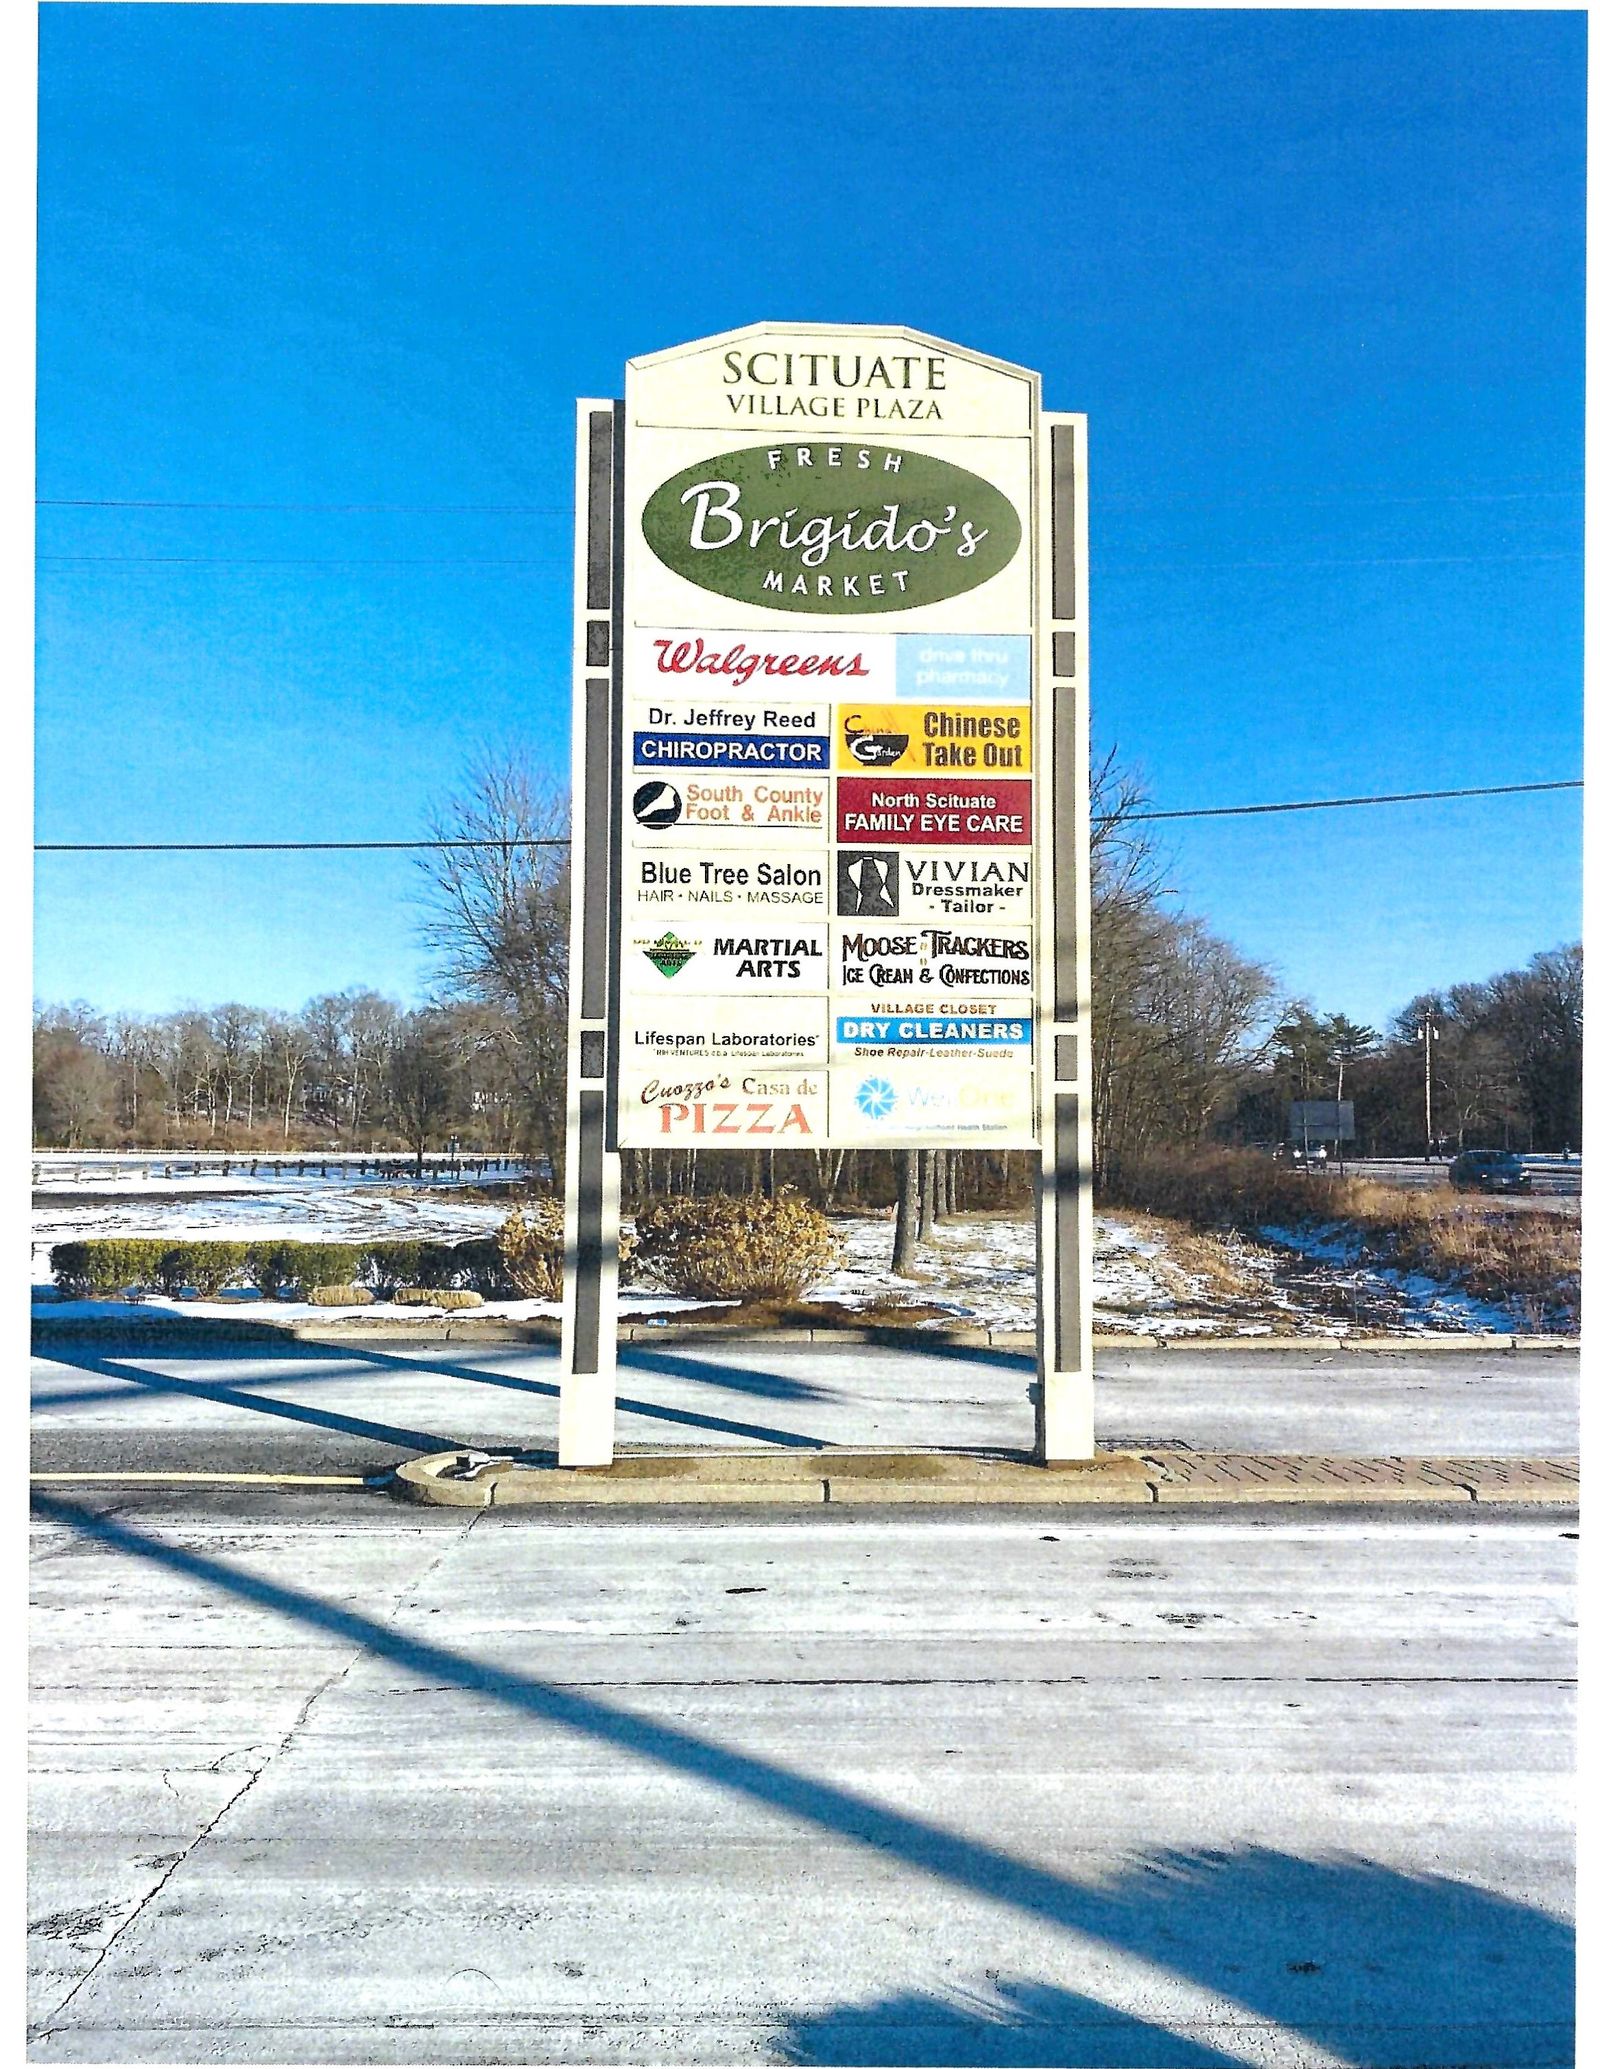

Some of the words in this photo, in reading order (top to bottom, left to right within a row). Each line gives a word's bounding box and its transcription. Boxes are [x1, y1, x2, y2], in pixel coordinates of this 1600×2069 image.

[723, 351, 946, 390] SCITUATE
[726, 394, 846, 418] VILLAGE
[857, 398, 943, 420] PLAZA
[768, 447, 903, 473] FRESH
[680, 480, 988, 567] Brigido's
[763, 570, 909, 597] MARKET
[653, 637, 869, 686] Walgreens
[918, 645, 965, 663] drive
[970, 646, 1008, 663] thru
[916, 669, 1009, 689] pharmacy
[648, 708, 676, 726] Dr.
[684, 709, 756, 731] Jeffrey
[763, 710, 816, 729] Reed
[923, 711, 1021, 739] Chinese
[641, 739, 822, 762] CHIROPRACTOR
[923, 742, 977, 767] Take
[983, 743, 1022, 768] Out
[686, 784, 743, 802] South
[754, 786, 823, 806] County
[872, 792, 919, 808] North
[925, 793, 996, 809] Scituate
[686, 804, 729, 821] Foot
[742, 804, 755, 822] &
[767, 805, 822, 823] Ankle
[844, 813, 916, 831] FAMILY
[921, 814, 961, 832] EYE
[967, 815, 1023, 833] CARE
[642, 861, 691, 884] Blue
[700, 861, 749, 885] Tree
[757, 862, 821, 886] Salon
[905, 860, 1029, 883] VIVIAN
[638, 889, 674, 902] HAIR
[688, 890, 733, 903] NAILS
[747, 891, 824, 904] MASSAGE
[912, 883, 1024, 897] Dressmaker
[941, 899, 994, 913] Tailor
[713, 938, 823, 956] MARTIAL
[736, 960, 801, 978] ARTS
[919, 967, 934, 983] &
[871, 1003, 934, 1014] VILLAGE
[939, 1003, 997, 1015] CLOSET
[635, 1031, 705, 1048] Lifespan
[843, 1021, 890, 1039] DRY
[898, 1022, 1024, 1040] CLEANERS
[854, 1047, 884, 1057] Shoe
[641, 1073, 731, 1105] Cuozzo's
[742, 1077, 790, 1095] Casa
[797, 1078, 818, 1095] de
[659, 1103, 813, 1134] PIZZA
